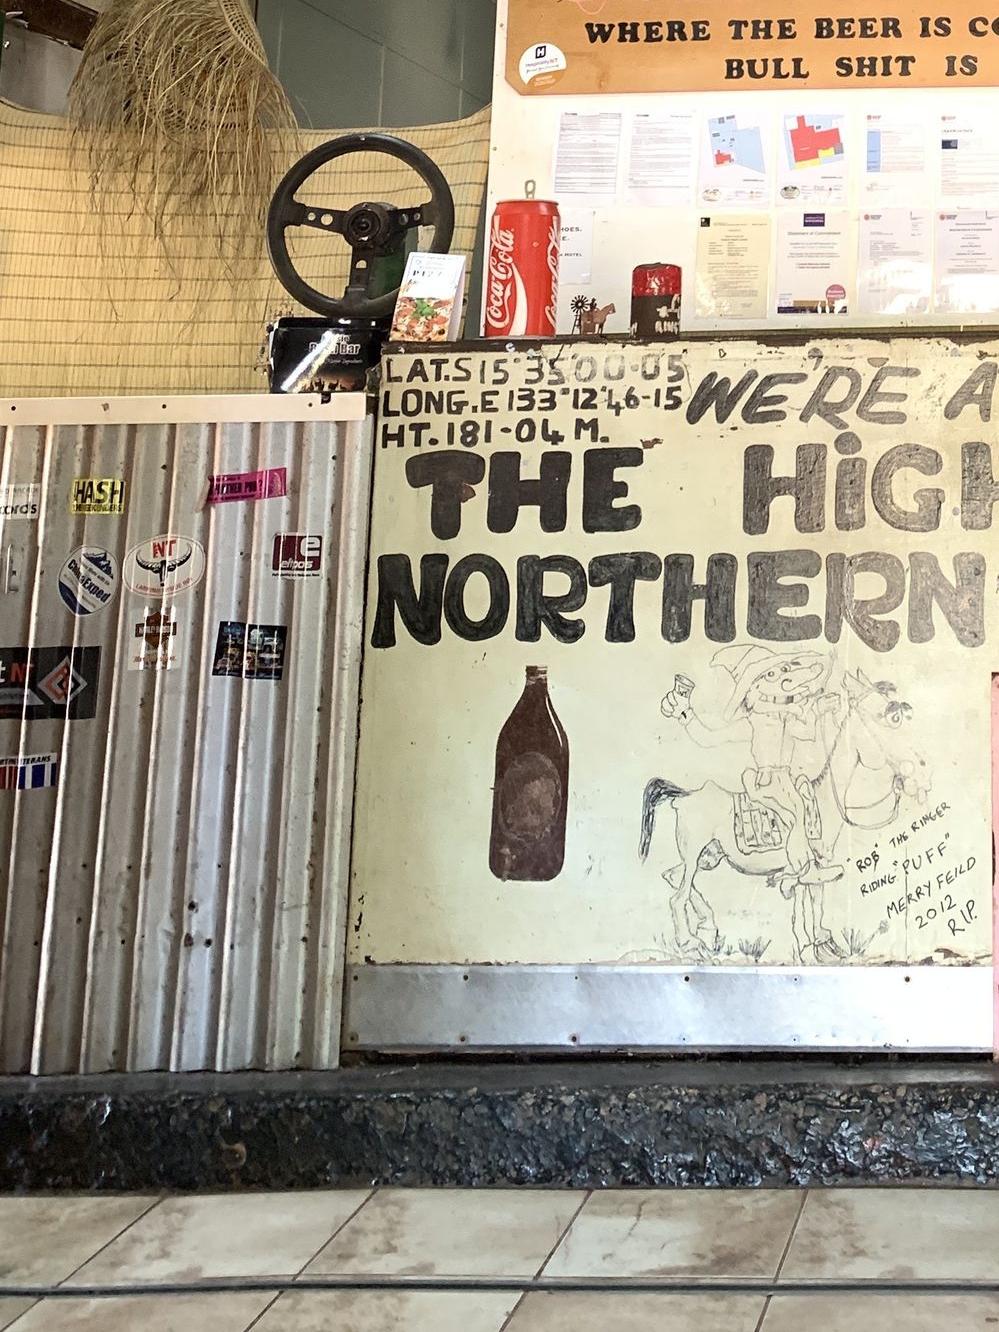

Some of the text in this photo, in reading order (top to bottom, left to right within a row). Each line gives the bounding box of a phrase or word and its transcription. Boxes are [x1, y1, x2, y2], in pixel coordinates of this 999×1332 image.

[585, 16, 711, 45] WHERE
[727, 16, 797, 42] THE
[813, 15, 904, 40] BEER
[920, 15, 953, 39] IS
[724, 54, 809, 81] BULL
[835, 54, 915, 79] SHIT
[945, 54, 978, 78] IS
[340, 343, 361, 355] Bar
[685, 352, 920, 430] WE'RE
[74, 480, 125, 504] HASH
[404, 446, 644, 540] THE
[152, 540, 176, 558] NT
[371, 549, 986, 653] NORTHERN
[889, 831, 909, 848] THE
[911, 802, 951, 832] RINGER
[860, 874, 897, 897] RIDING
[886, 856, 976, 919] MERRY FEILD
[915, 894, 957, 929] 2012
